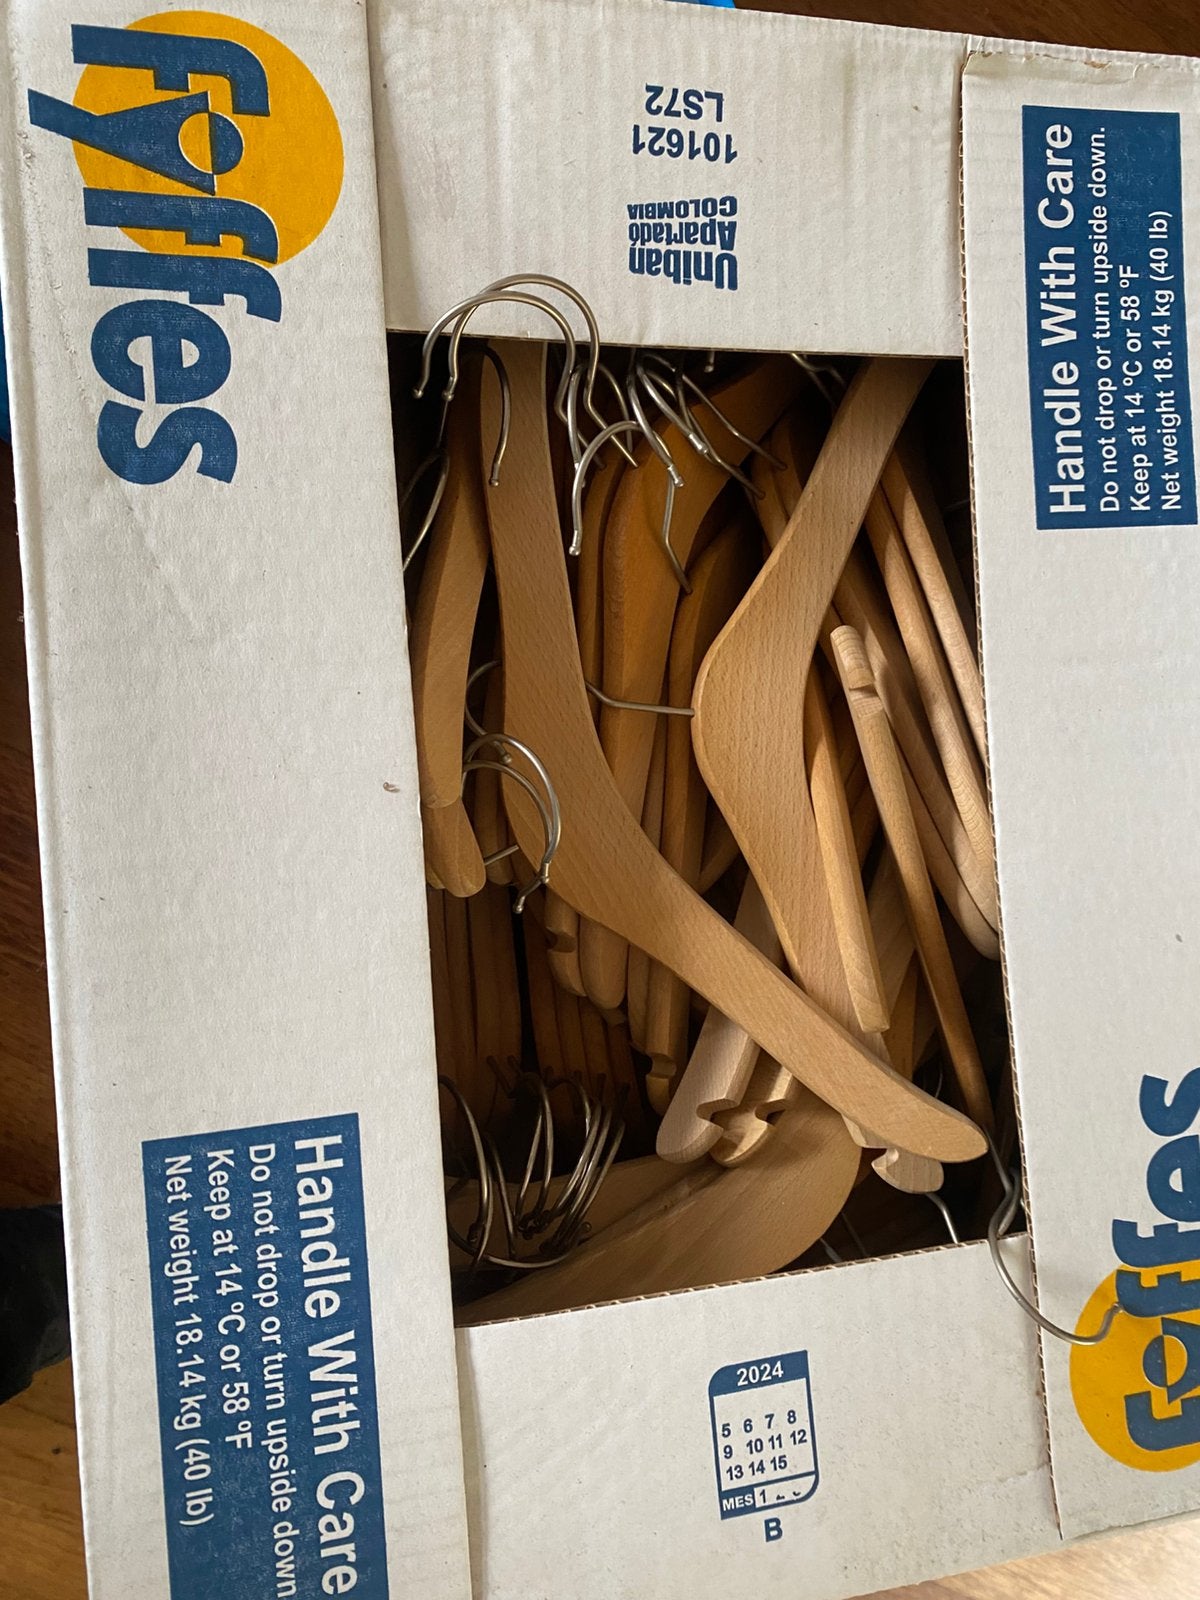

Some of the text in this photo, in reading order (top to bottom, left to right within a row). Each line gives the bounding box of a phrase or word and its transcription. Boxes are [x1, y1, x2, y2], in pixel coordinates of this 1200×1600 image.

[646, 84, 724, 122] LS72
[633, 124, 737, 164] 101621
[627, 196, 737, 220] COLOMBIA
[629, 218, 736, 251] Apartadó
[629, 247, 738, 290] Uniban
[1038, 124, 1086, 512] Handle With Care
[1087, 127, 1121, 512] Do not drop or turn upside down.
[1119, 295, 1141, 321] 58
[1125, 327, 1142, 353] or
[1147, 211, 1181, 511] Net weight 18.14 kg (40 lb)
[1123, 392, 1145, 418] 14
[1126, 425, 1147, 447] at
[1129, 453, 1153, 511] Keep
[204, 1150, 234, 1220] Keep
[212, 1230, 238, 1256] at
[216, 1264, 242, 1296] 14
[164, 1156, 214, 1525] Net weight 18.14 kg (40 lb)
[219, 1343, 241, 1373] or
[250, 1144, 300, 1598] Do not drop or turn upside down
[295, 1135, 364, 1594] Handle With Care
[737, 1361, 784, 1386] 2024
[222, 1382, 250, 1414] 58
[721, 1409, 797, 1439] 5 6 7 8
[723, 1429, 808, 1460] 9 10 11 12
[725, 1454, 788, 1481] 13 14 15
[722, 1493, 754, 1511] MES
[763, 1517, 783, 1543] B
